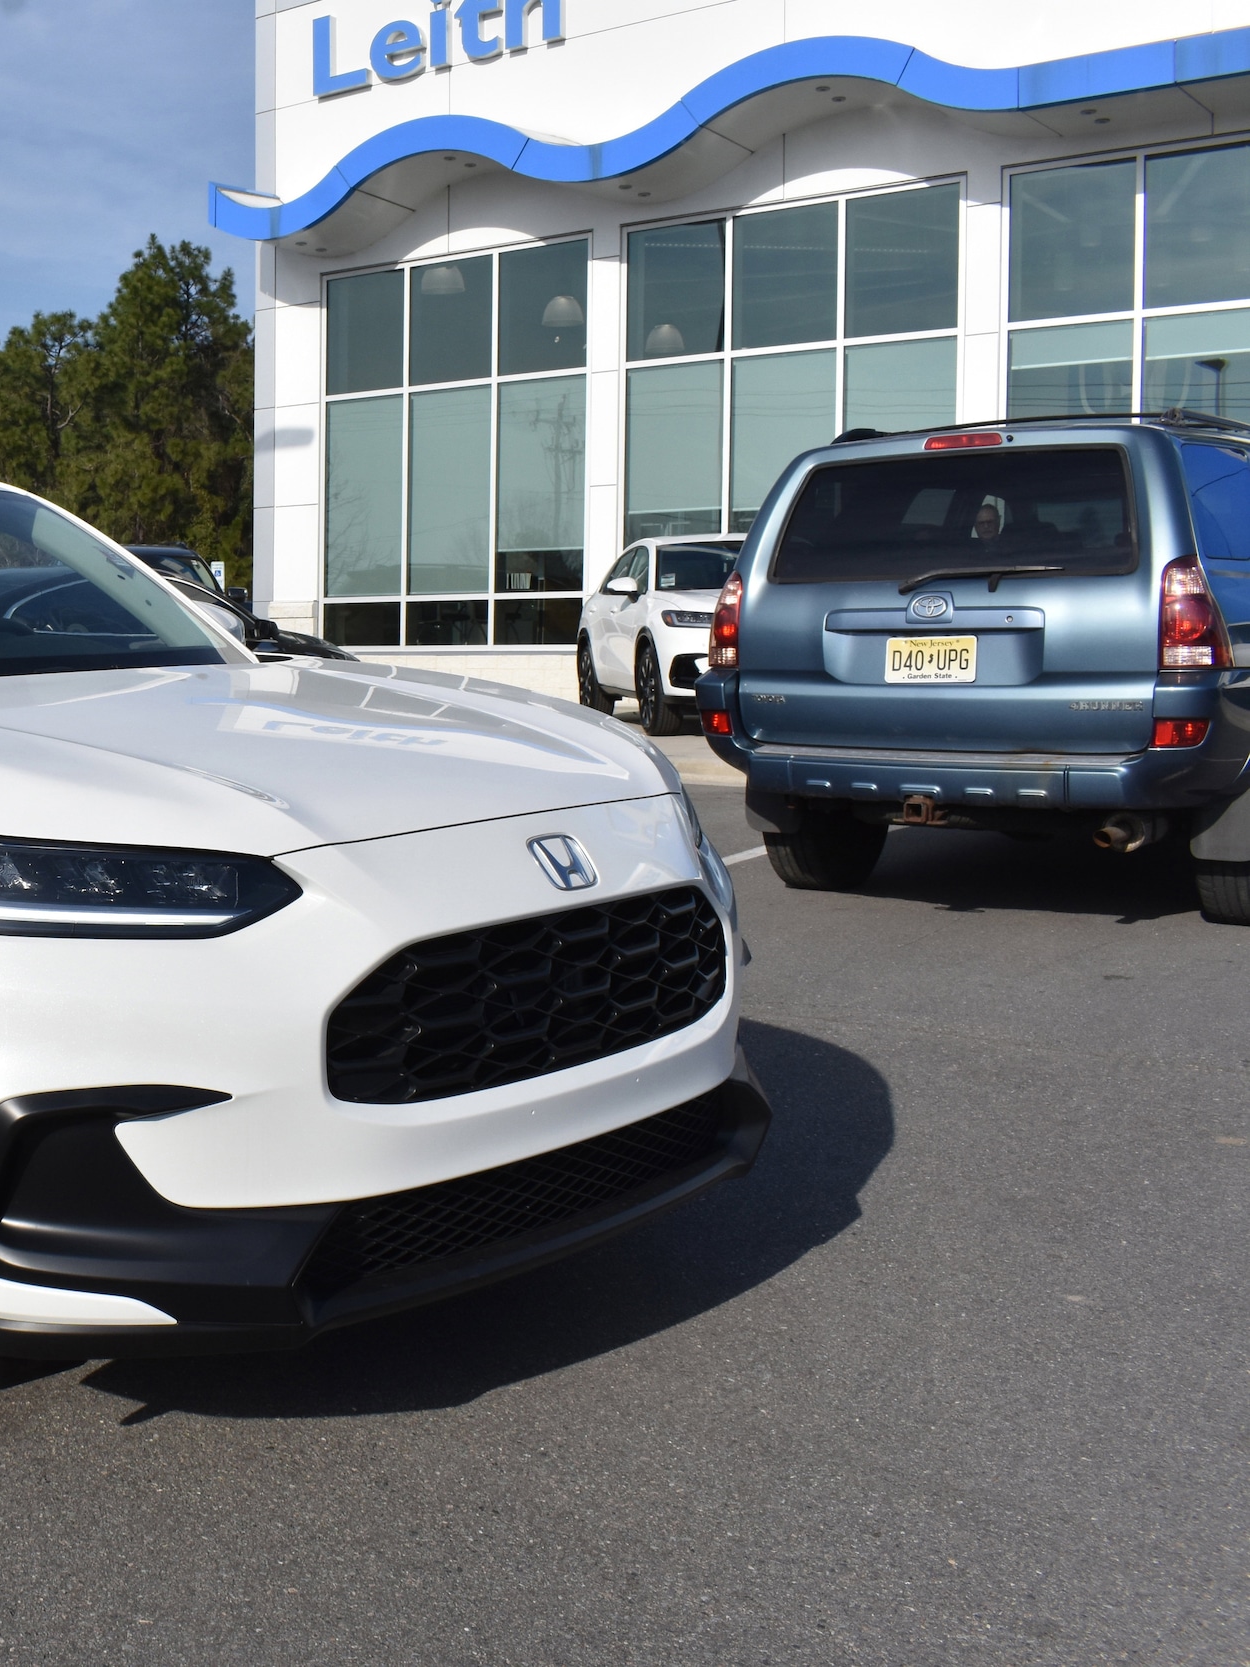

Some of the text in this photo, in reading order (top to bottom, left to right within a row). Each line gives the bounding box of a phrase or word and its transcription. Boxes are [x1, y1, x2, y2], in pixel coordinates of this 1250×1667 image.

[312, 0, 563, 97] Leith
[929, 640, 954, 648] Jersey
[892, 649, 969, 671] D40 UPG
